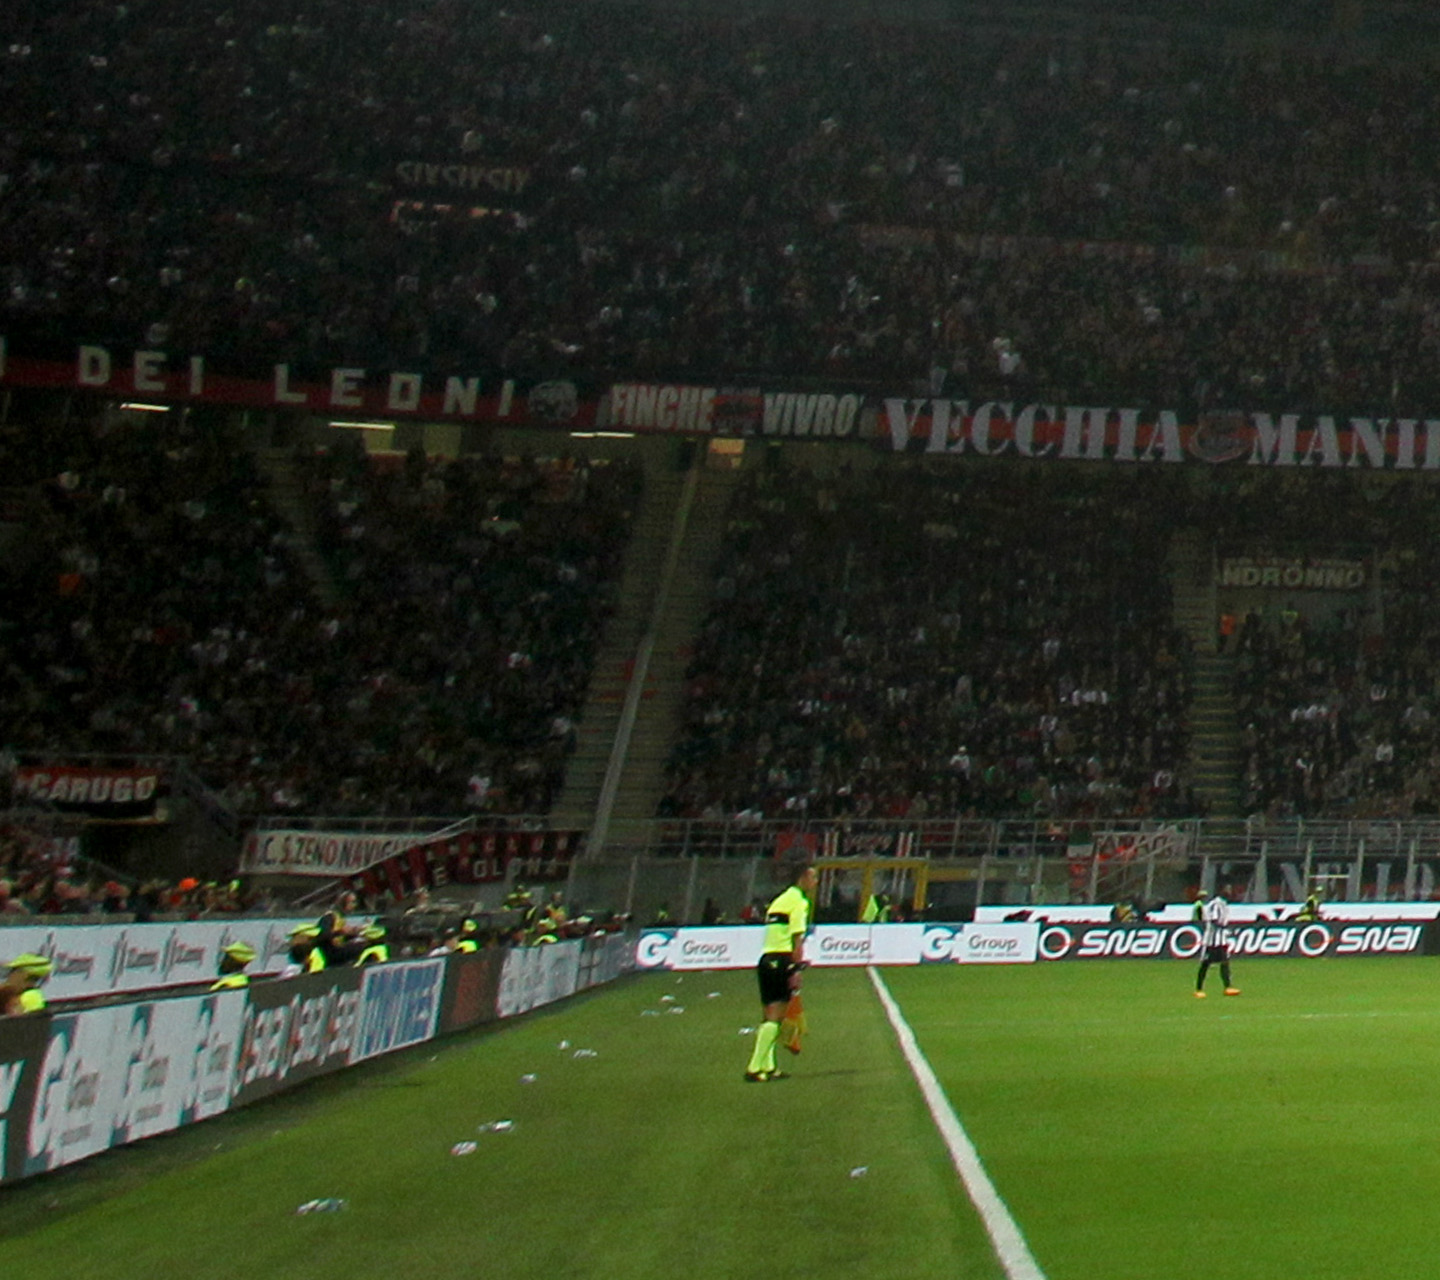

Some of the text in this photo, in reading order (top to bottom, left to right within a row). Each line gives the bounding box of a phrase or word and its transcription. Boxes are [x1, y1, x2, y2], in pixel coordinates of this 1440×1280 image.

[76, 343, 517, 417] DEI LEONI
[610, 383, 717, 433] FINCHE
[883, 396, 1185, 463] VECCHIA
[29, 773, 157, 803] CARUGO
[682, 940, 728, 956] Group
[820, 936, 870, 952] Group
[968, 935, 1020, 951] Group
